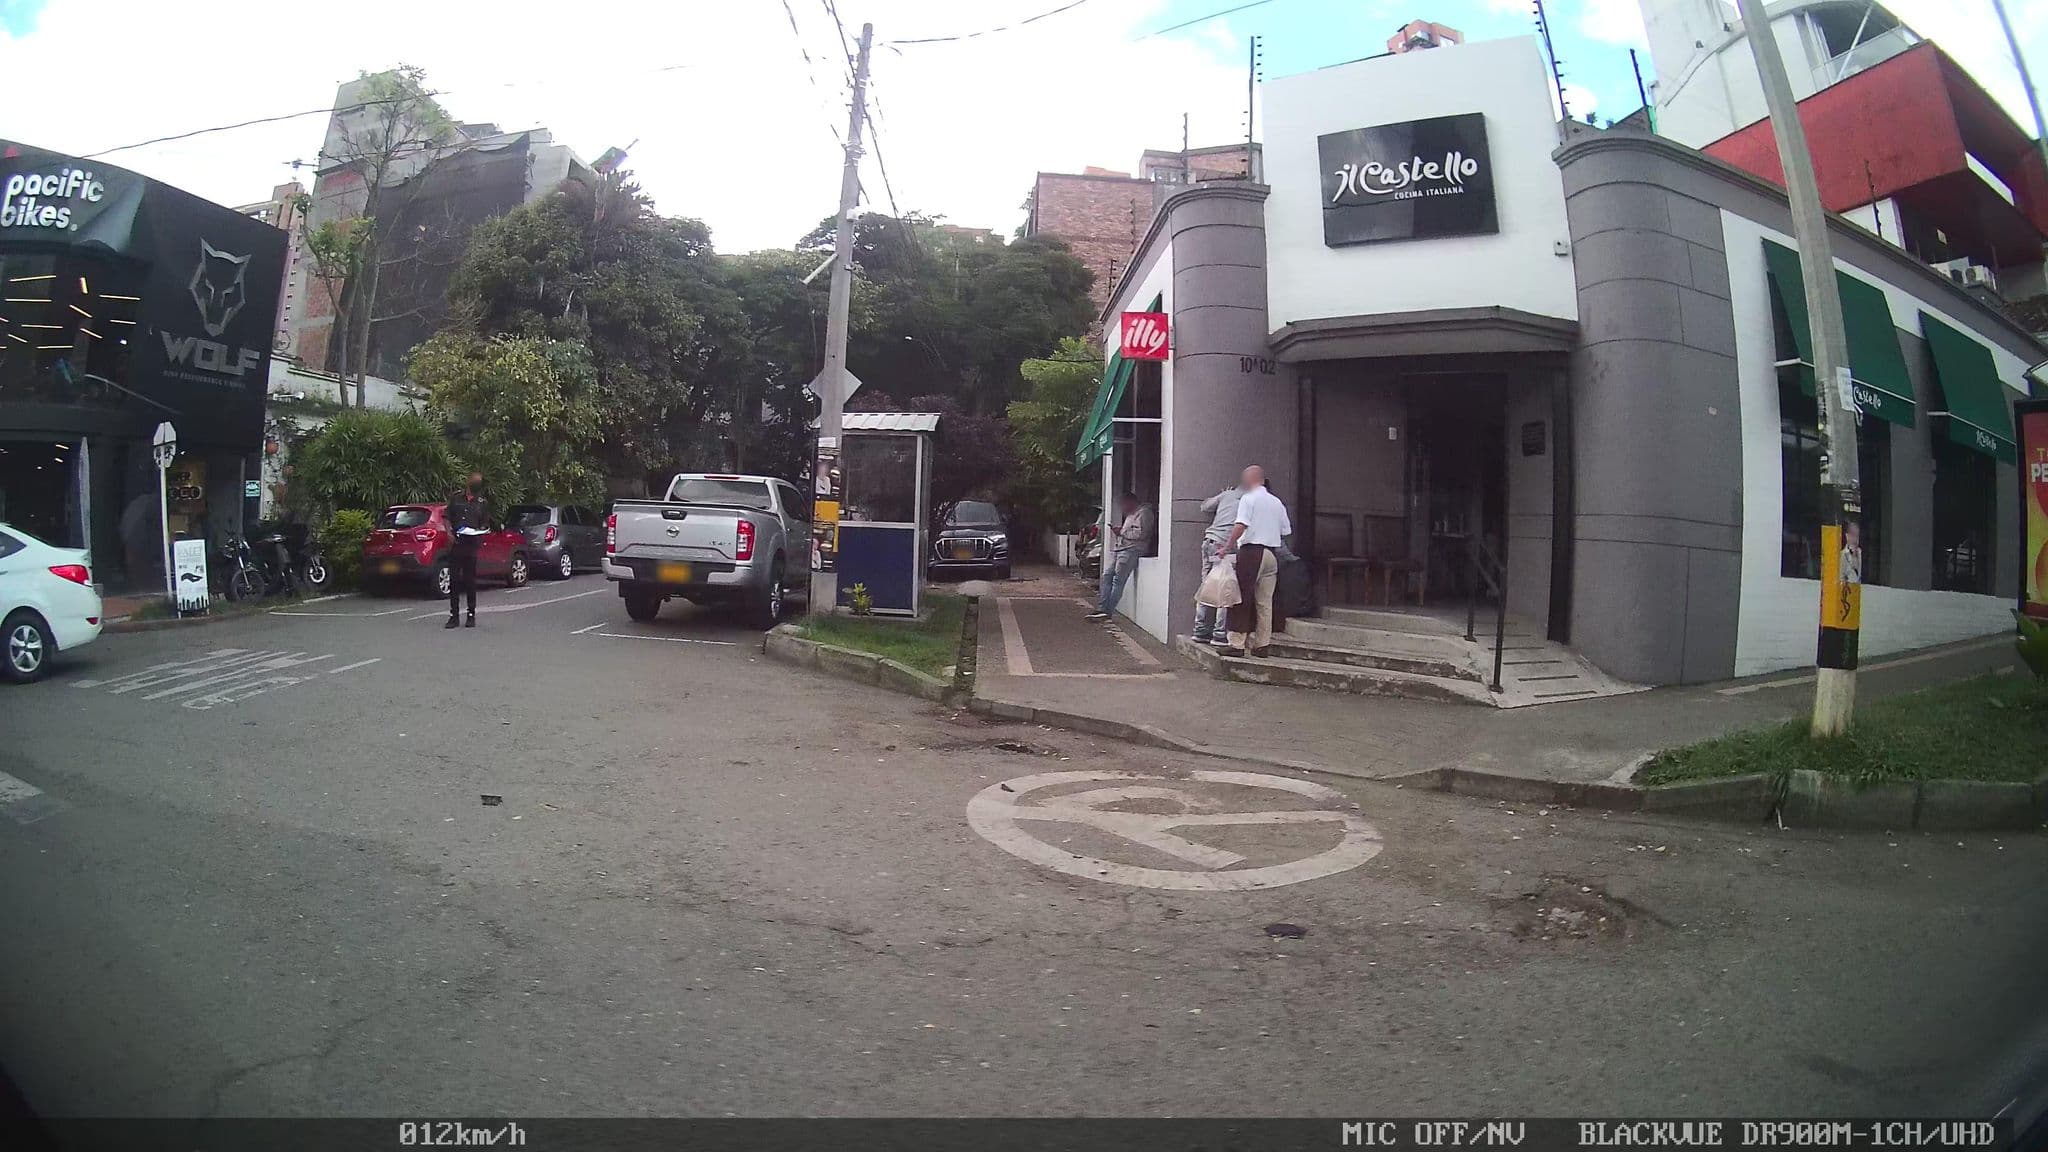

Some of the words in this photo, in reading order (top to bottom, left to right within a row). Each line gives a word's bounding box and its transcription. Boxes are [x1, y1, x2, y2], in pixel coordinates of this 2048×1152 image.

[5, 168, 104, 204] pacific
[1394, 190, 1423, 200] COCINA
[1426, 186, 1464, 197] ITALIANA
[160, 330, 260, 376] WOLF
[1124, 319, 1166, 355] illy
